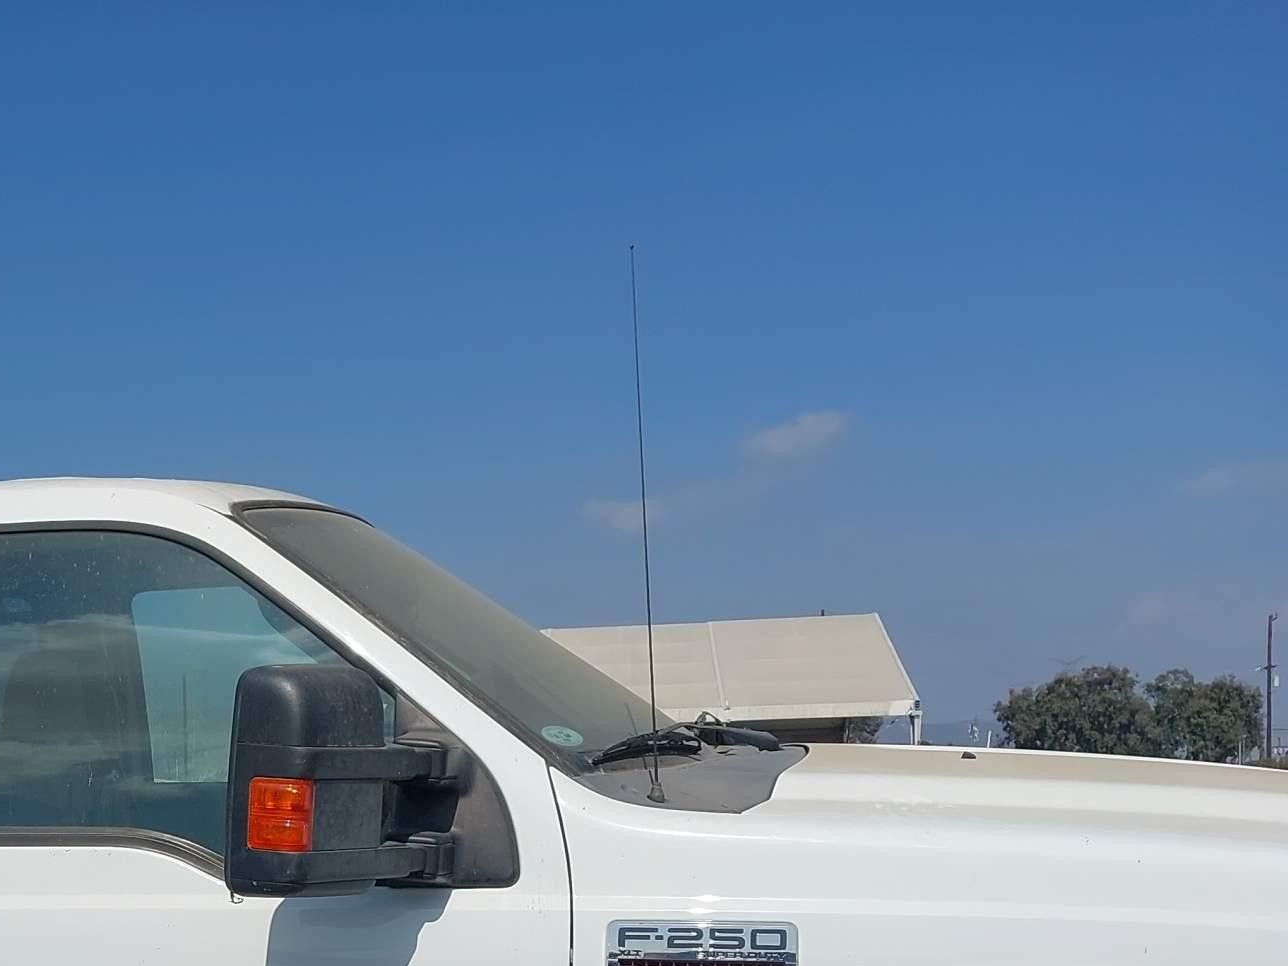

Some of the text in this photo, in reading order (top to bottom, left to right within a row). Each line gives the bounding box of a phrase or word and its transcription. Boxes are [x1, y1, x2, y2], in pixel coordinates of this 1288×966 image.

[618, 927, 788, 951] F-250
[618, 949, 788, 962] XLT SUPER DUTY
